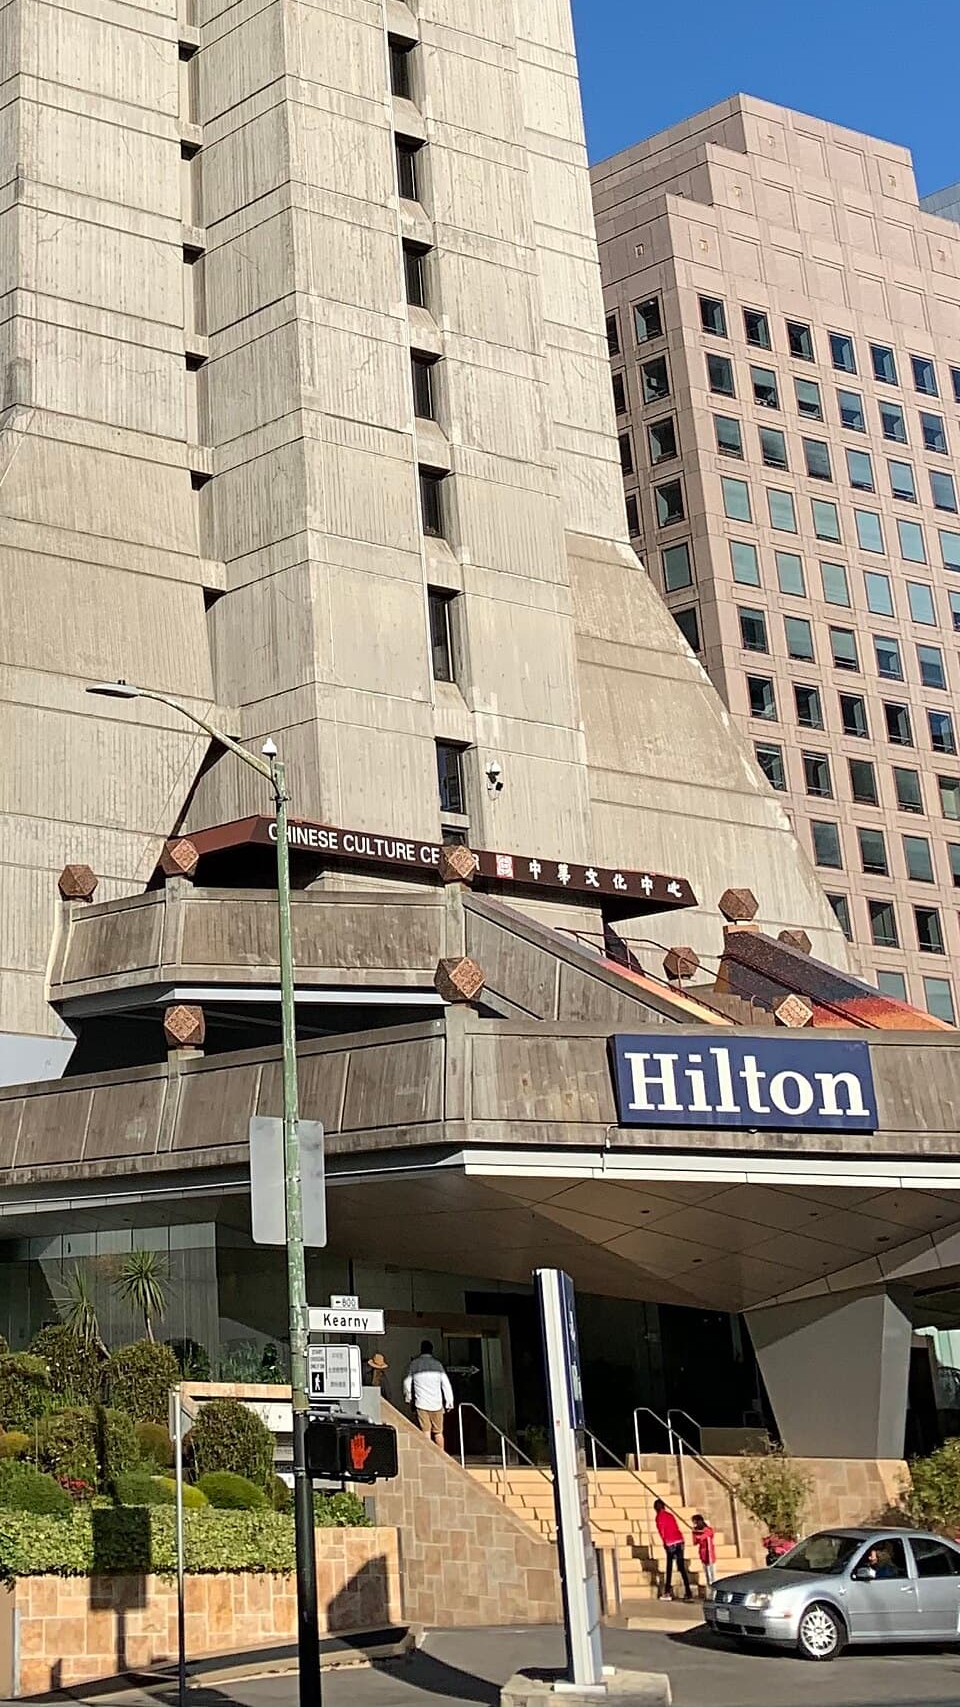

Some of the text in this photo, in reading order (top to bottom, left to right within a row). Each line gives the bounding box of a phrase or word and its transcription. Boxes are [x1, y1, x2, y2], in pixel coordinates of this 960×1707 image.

[343, 834, 416, 862] CULTURE
[529, 859, 683, 898] 中華文化中心
[624, 1047, 870, 1116] Hilton
[323, 1313, 368, 1330] Kearny
